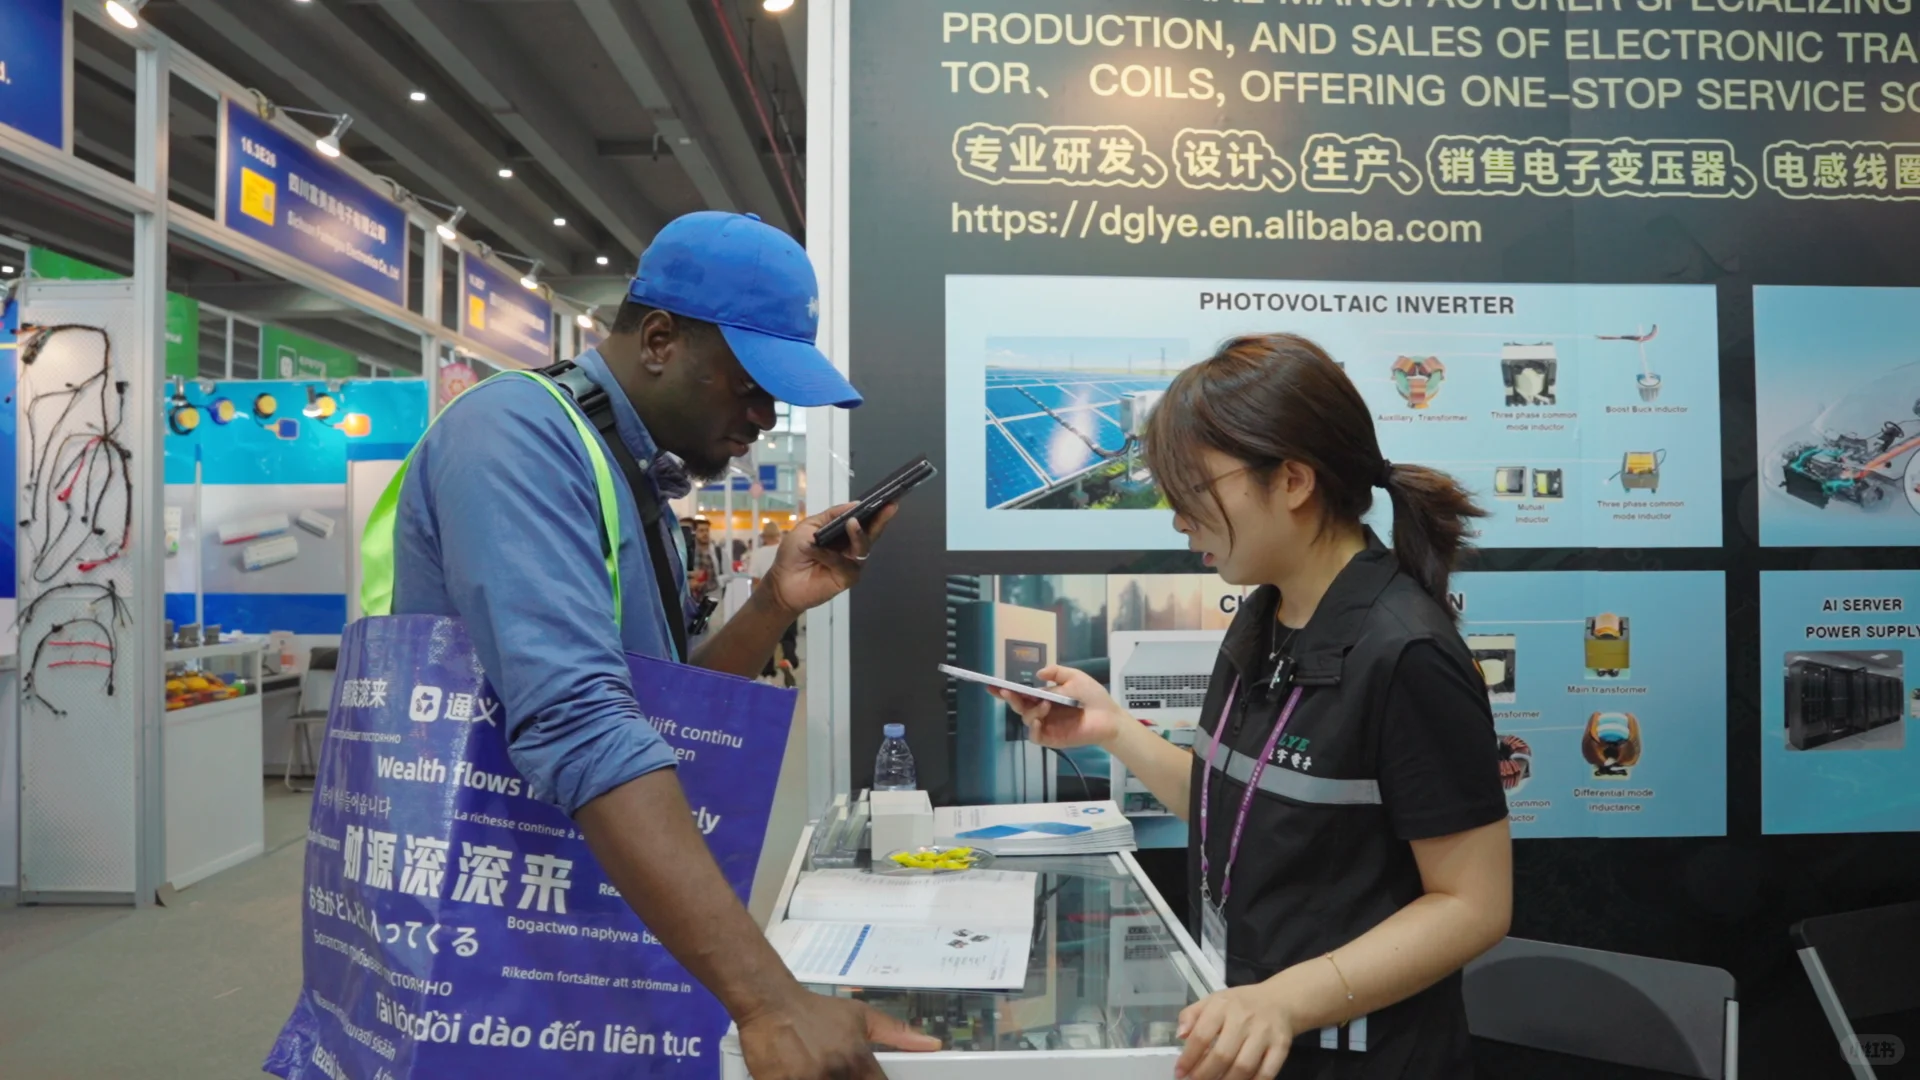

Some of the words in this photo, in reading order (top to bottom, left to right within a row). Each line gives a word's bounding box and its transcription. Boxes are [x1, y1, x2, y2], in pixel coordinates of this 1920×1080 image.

[942, 12, 1235, 57] PRODUCTION,
[1249, 22, 1337, 55] AND
[1351, 25, 1483, 57] SALES
[1496, 28, 1550, 60] OF
[1565, 29, 1823, 63] ELECTRONIC
[1089, 63, 1226, 107] COILS,
[1240, 70, 1446, 107] OFFERING
[1696, 79, 1866, 113] SERVICE
[951, 201, 1482, 244] https://dglye.en.alibaba.com
[1200, 293, 1388, 314] PHOTOVOLTAIC
[1397, 296, 1515, 315] INVERTER
[1605, 405, 1629, 414] Boost
[1655, 405, 1688, 414] inductor
[1419, 414, 1468, 422] Transformer
[1491, 411, 1514, 420] Three
[1516, 411, 1540, 421] phase
[1542, 412, 1578, 420] common
[1506, 423, 1528, 431] mode
[1531, 423, 1565, 432] inductor
[1597, 499, 1621, 508] Three
[1623, 500, 1647, 509] phase
[1649, 500, 1684, 508] common
[1613, 512, 1636, 521] mode
[1638, 512, 1671, 521] inductor
[1823, 600, 1837, 611] AI
[1843, 599, 1902, 611] SERVER
[1806, 626, 1860, 639] POWER
[1567, 685, 1589, 694] Main
[1592, 685, 1647, 694] transformer
[443, 691, 499, 727] 通义
[1493, 710, 1540, 719] ansformer
[649, 716, 677, 737] lijft
[680, 725, 744, 749] continu
[377, 755, 446, 783] Wealth
[453, 761, 522, 797] flows
[1573, 788, 1625, 798] Differential
[1628, 788, 1654, 797] mode
[1510, 800, 1551, 808] common
[1588, 803, 1641, 812] inductance
[454, 809, 468, 820] La
[470, 813, 516, 829] richesse
[518, 822, 566, 838] continue
[507, 916, 578, 935] Bogactwo
[581, 927, 639, 944] napływa
[502, 966, 554, 982] Rikedom
[557, 971, 611, 988] fortsätter
[612, 976, 629, 989] att
[631, 979, 679, 993] strömma
[680, 982, 692, 993] in
[414, 1010, 463, 1043] dồi
[468, 1014, 532, 1048] dào
[538, 1020, 596, 1052] đến
[603, 1024, 656, 1056] liên
[662, 1030, 702, 1064] tục
